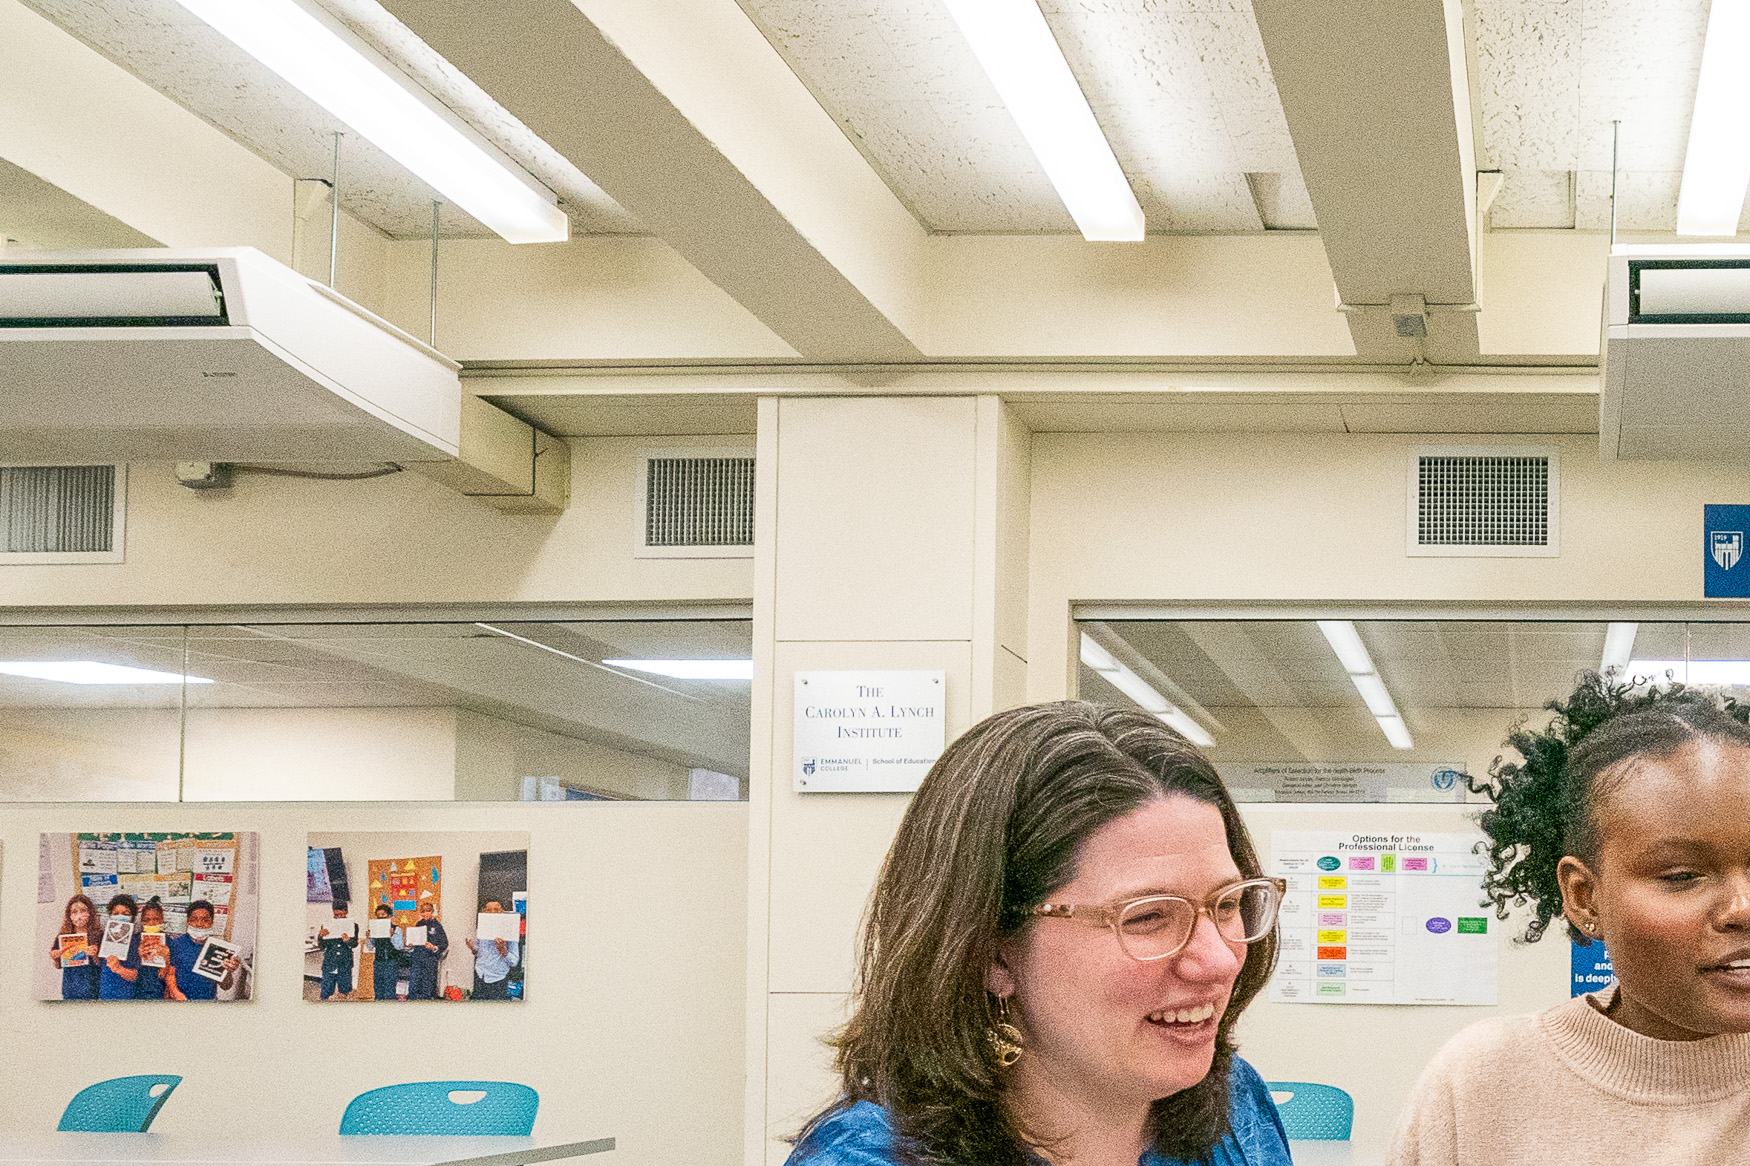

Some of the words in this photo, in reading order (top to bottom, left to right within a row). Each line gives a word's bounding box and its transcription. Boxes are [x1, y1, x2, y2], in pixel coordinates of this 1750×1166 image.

[872, 706, 885, 718] A.
[1352, 834, 1389, 844] Options
[1391, 834, 1404, 843] for
[1405, 835, 1421, 843] the
[1338, 843, 1396, 851] Professional
[1398, 843, 1435, 852] License
[1575, 973, 1584, 983] is
